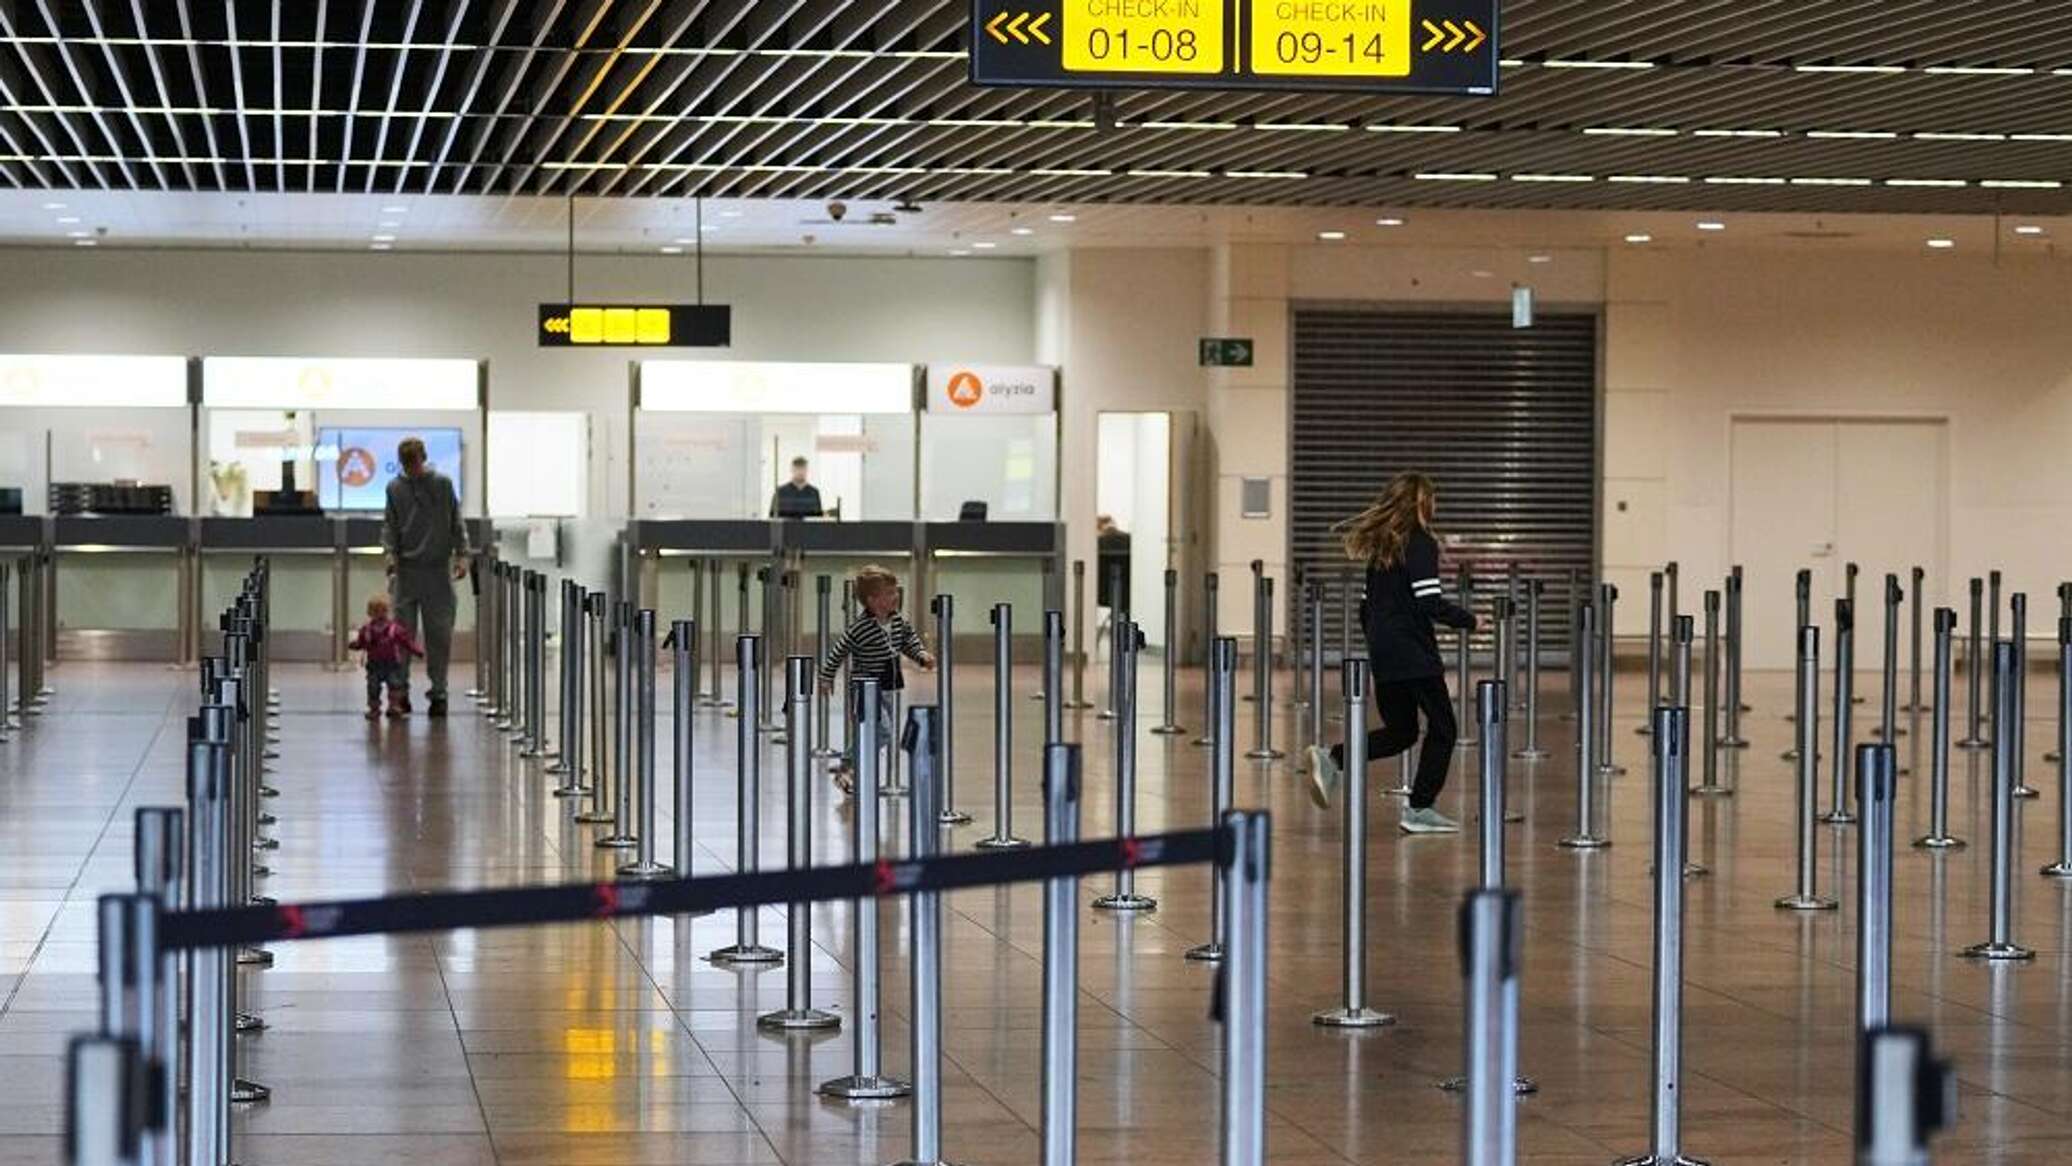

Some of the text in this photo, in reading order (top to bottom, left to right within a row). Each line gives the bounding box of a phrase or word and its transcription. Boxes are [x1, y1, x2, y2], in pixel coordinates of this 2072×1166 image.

[1088, 0, 1199, 18] CHECK-IN
[1277, 1, 1386, 22] CHECK-IN
[1089, 28, 1197, 61] 01-08
[1277, 31, 1385, 63] 09-14
